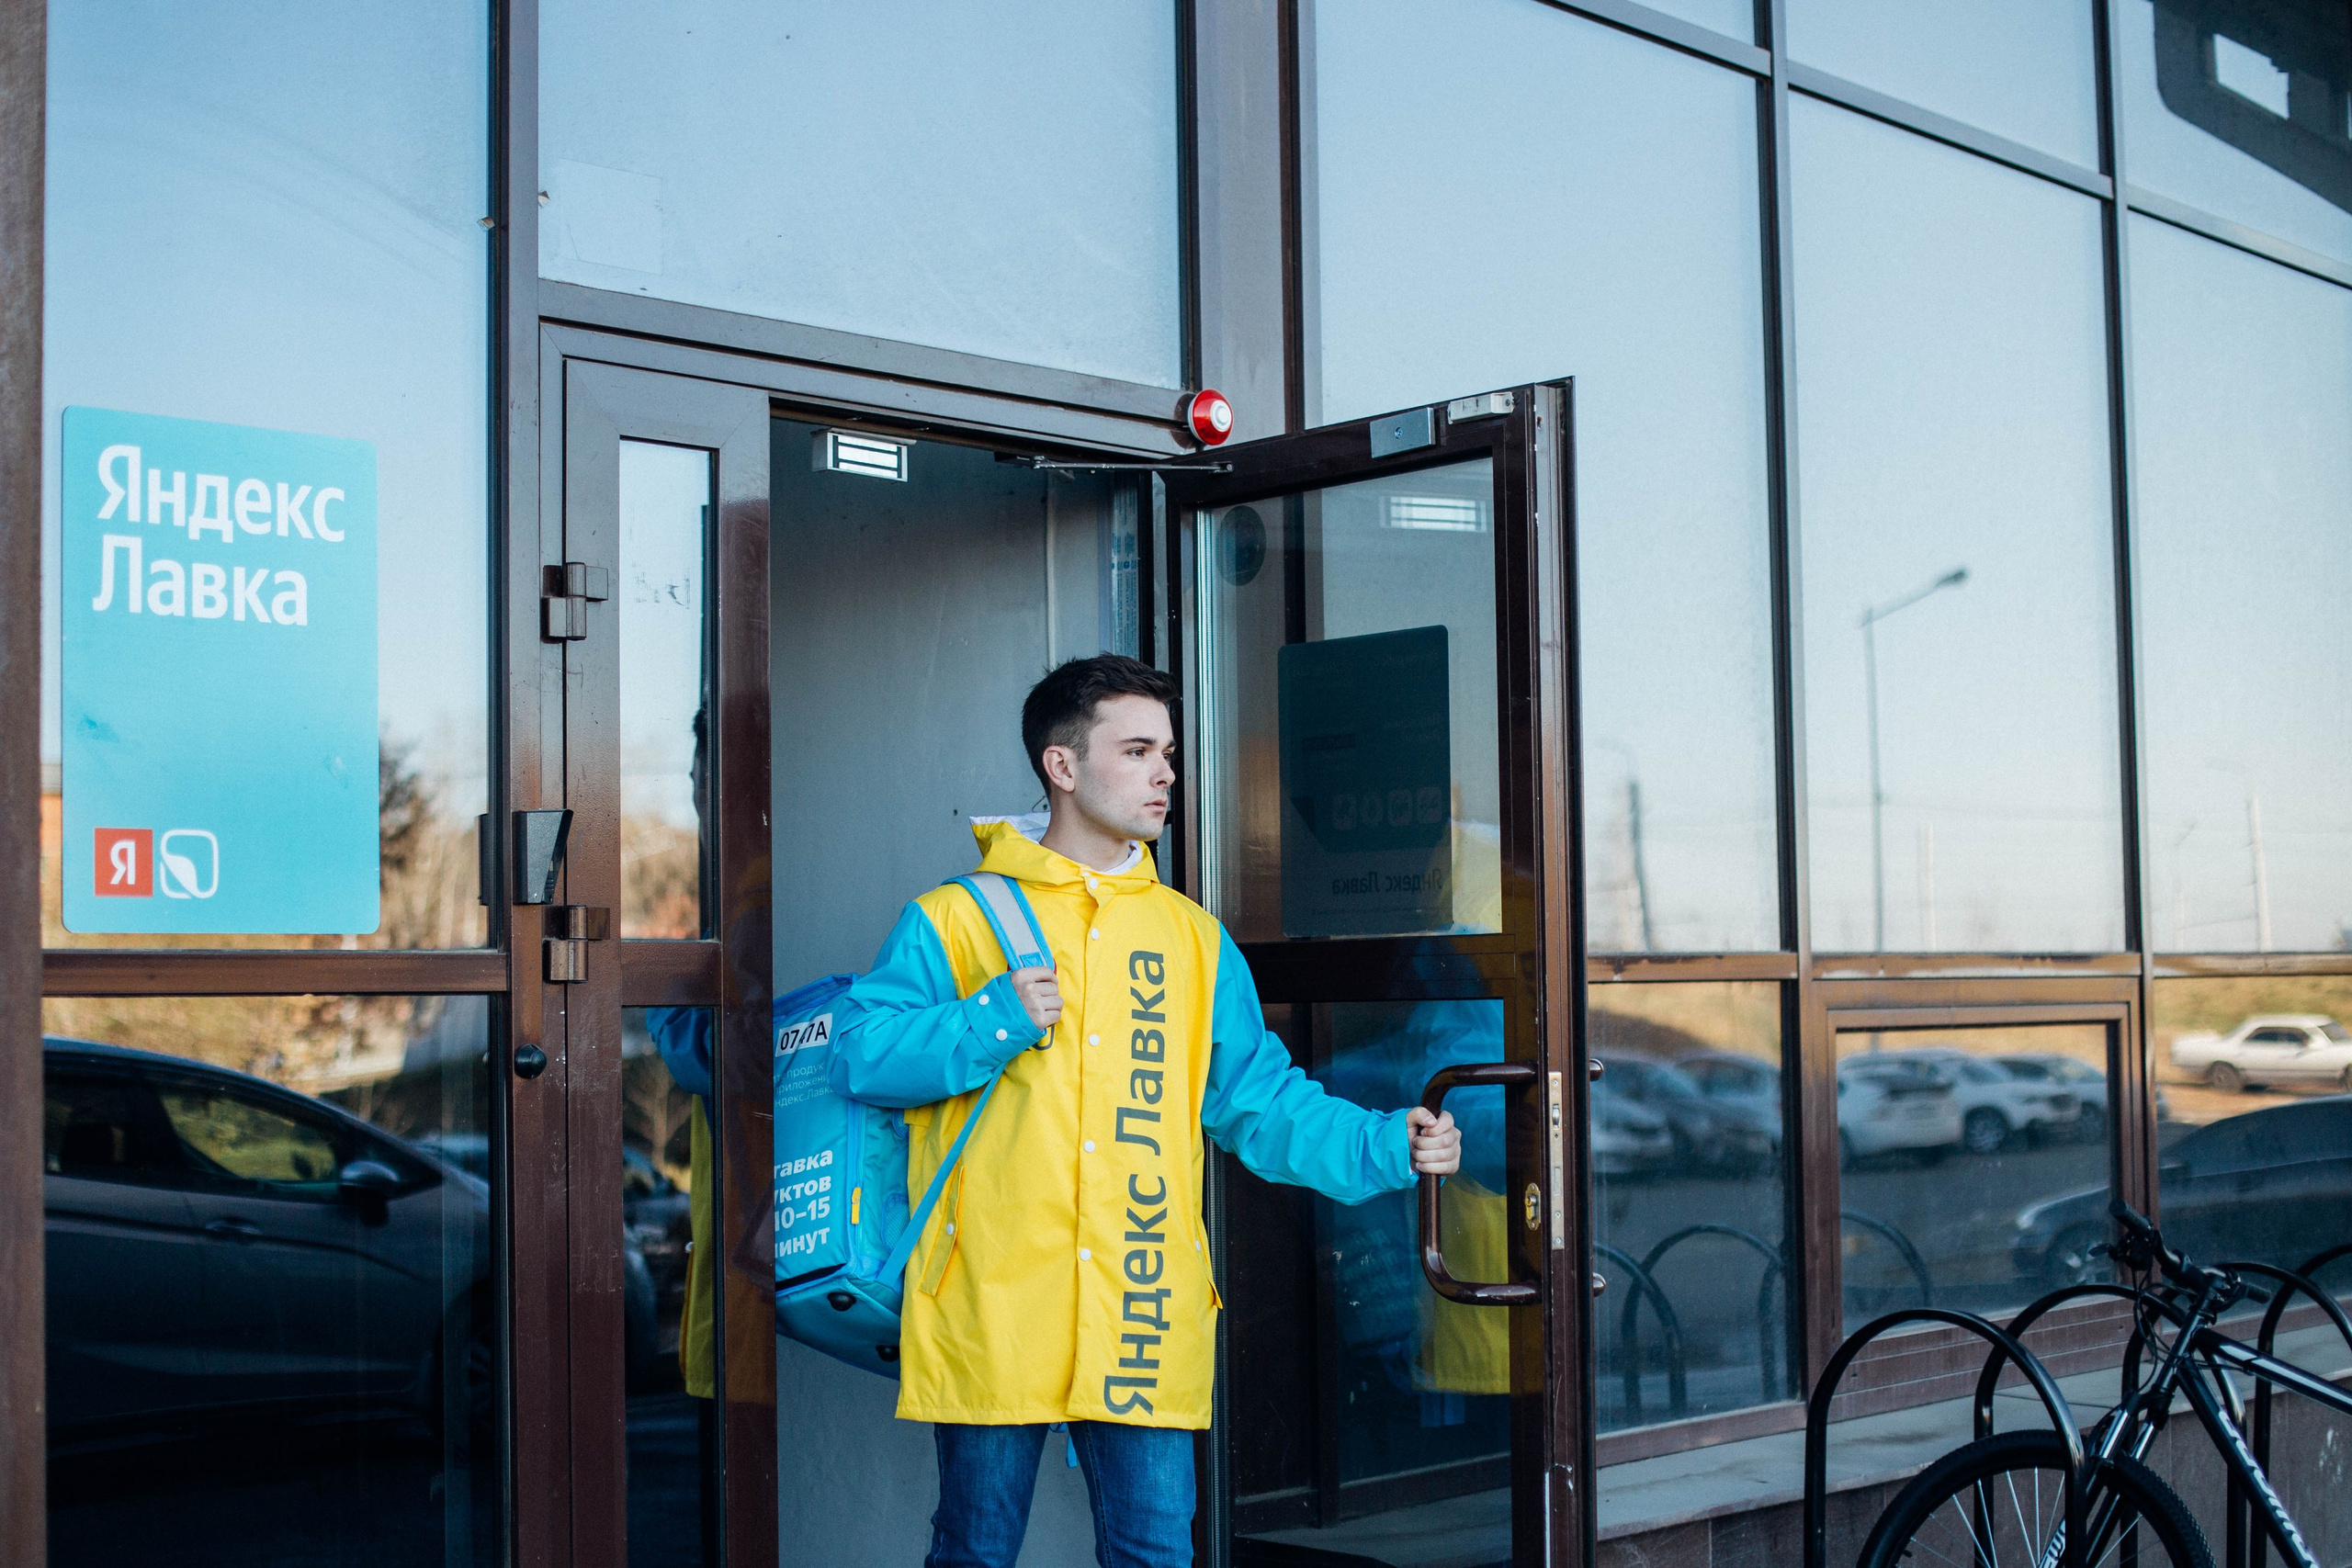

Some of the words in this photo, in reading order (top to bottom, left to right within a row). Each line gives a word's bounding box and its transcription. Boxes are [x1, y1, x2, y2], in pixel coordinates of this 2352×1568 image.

[96, 444, 345, 544] Яндекс
[92, 534, 309, 626] Лавка
[110, 840, 136, 886] Я
[786, 1062, 825, 1079] продук
[1114, 950, 1167, 1156] Лавка
[1103, 1174, 1172, 1416] Яндекс
